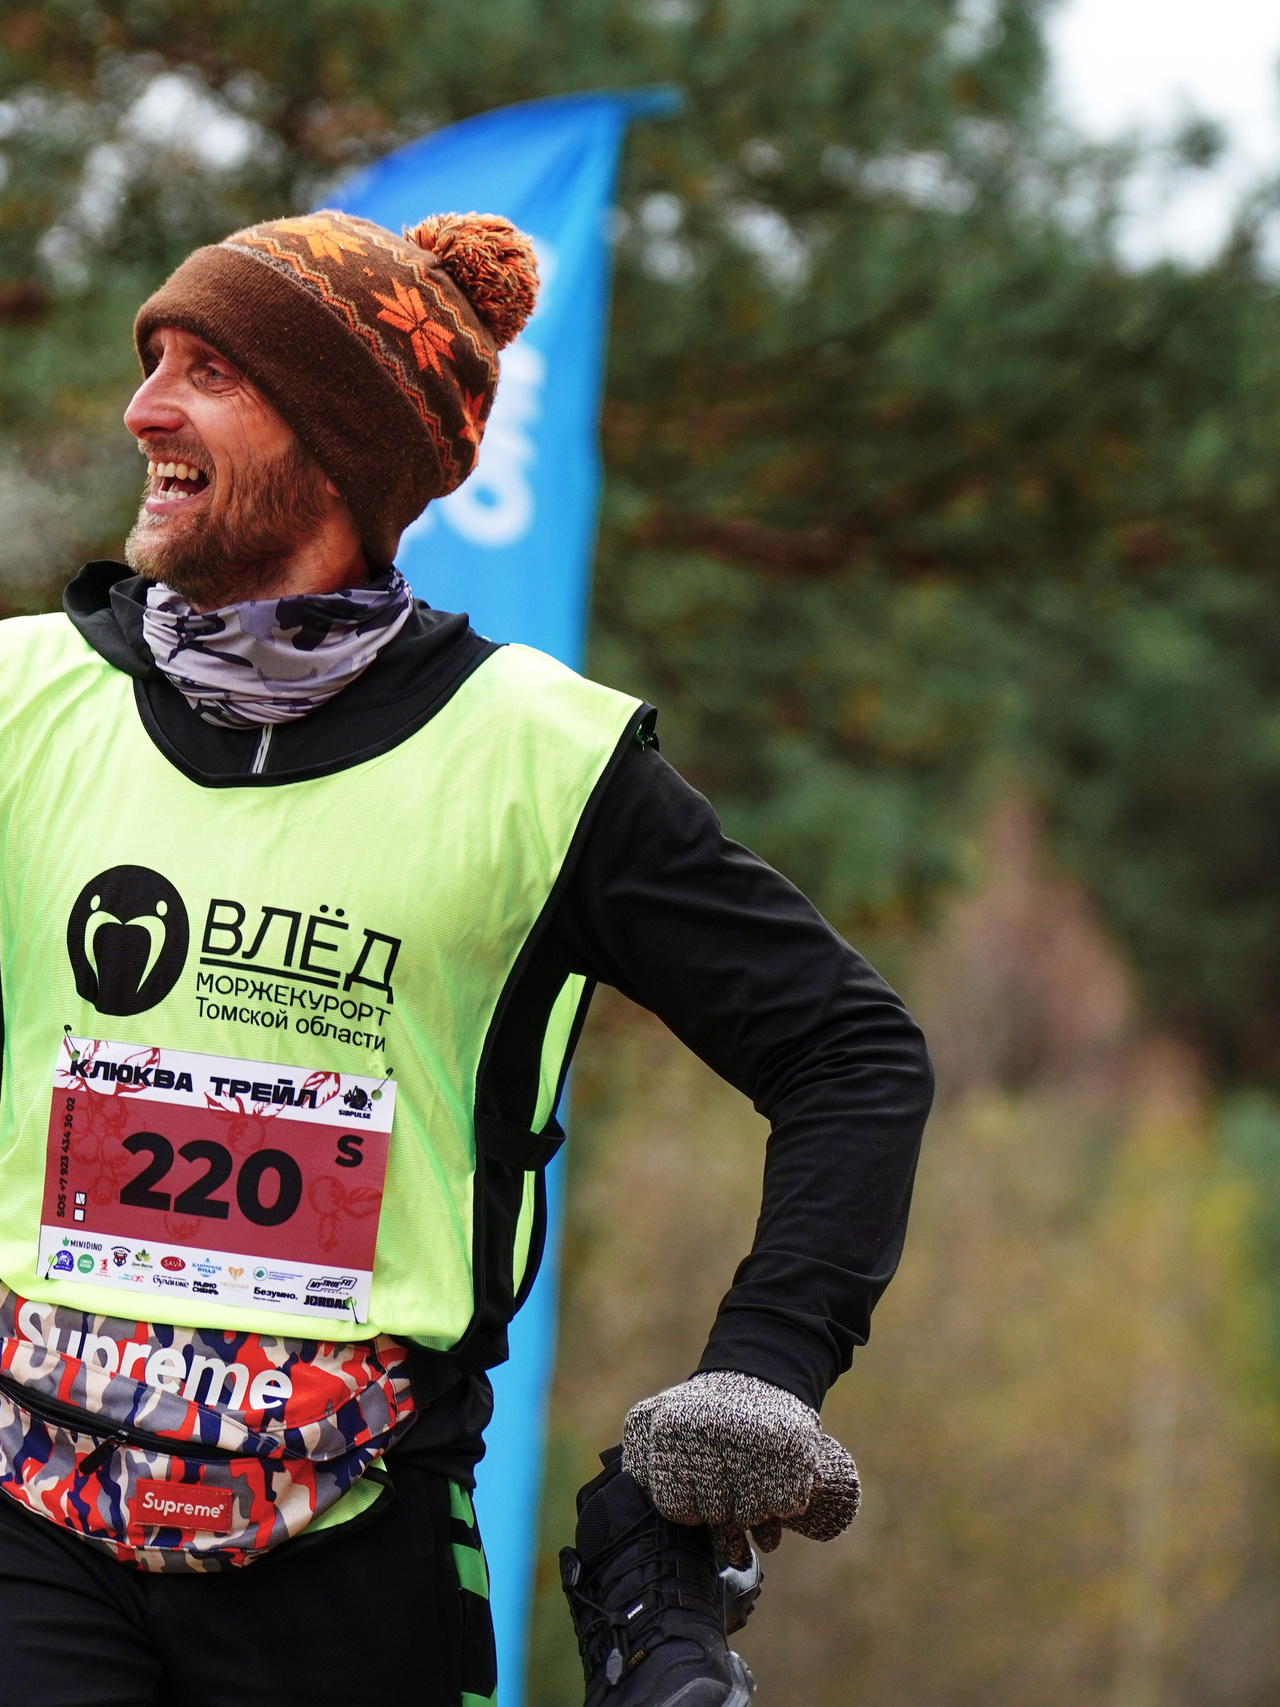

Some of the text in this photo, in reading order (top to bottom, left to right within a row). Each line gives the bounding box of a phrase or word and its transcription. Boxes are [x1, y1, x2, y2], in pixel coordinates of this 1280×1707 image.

[201, 898, 402, 1004] ВЛЁД
[196, 997, 386, 1052] Томской области
[197, 972, 391, 1026] МОРЖЕКУРОРТ
[70, 1059, 317, 1109] КЛЮКВА ТРЕЙЛ
[339, 1109, 371, 1119] SIBPULSE
[56, 1097, 75, 1218] SOS +7 923 434 30 02
[335, 1135, 364, 1167] S
[120, 1131, 302, 1227] 220
[70, 1239, 103, 1251] MINIDINO
[253, 1286, 298, 1300] Безумно.
[18, 1301, 293, 1410] Supreme
